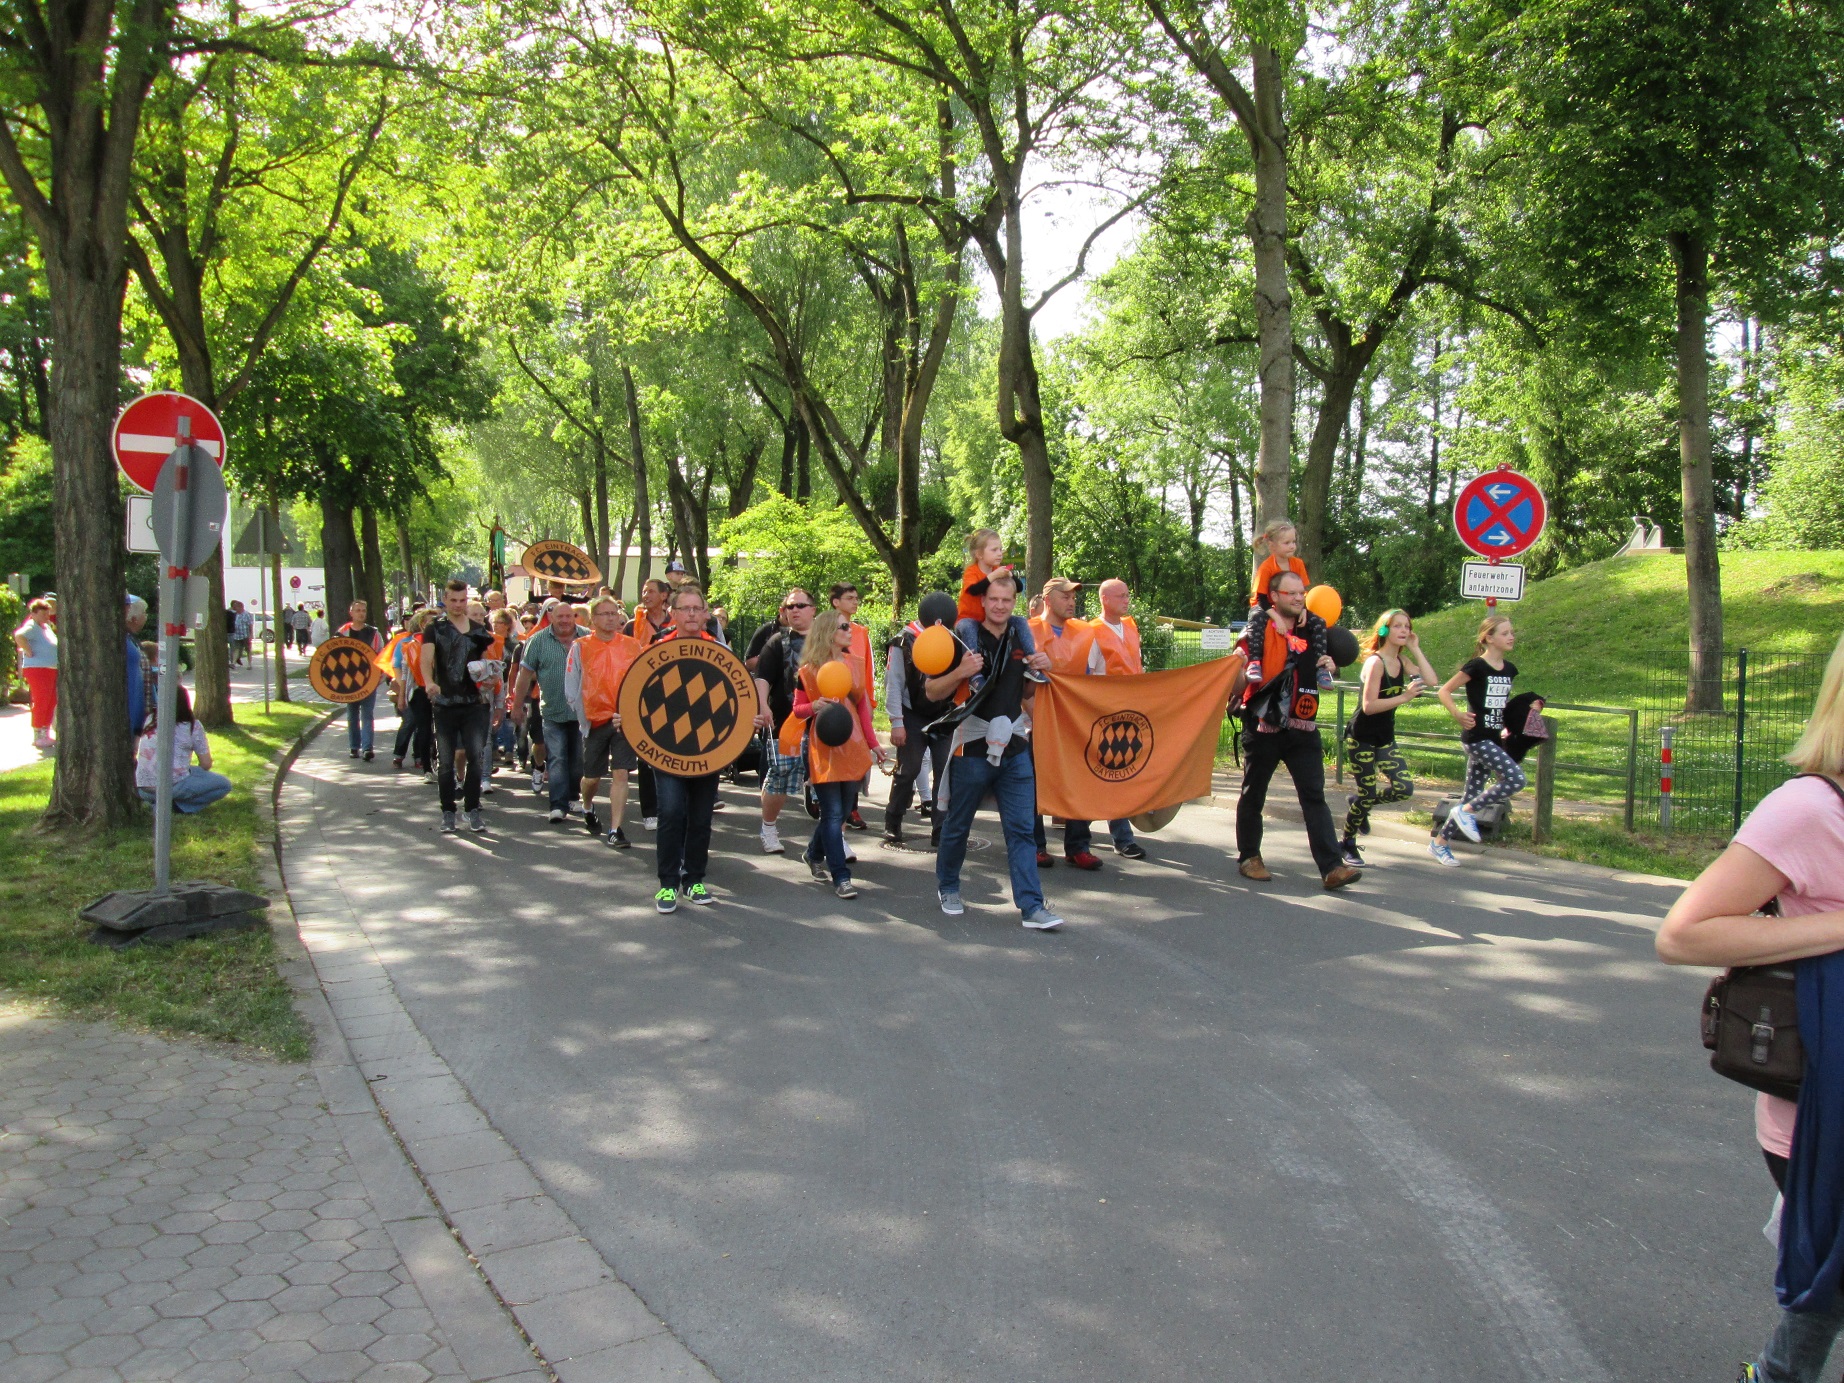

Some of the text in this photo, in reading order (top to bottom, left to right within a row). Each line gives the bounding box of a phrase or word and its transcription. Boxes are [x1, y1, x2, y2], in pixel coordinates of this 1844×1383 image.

[545, 543, 592, 565] EINTRACHT
[1469, 583, 1514, 594] anfahrtzone
[326, 639, 371, 655] EINTRACHT
[647, 644, 751, 699] F.C. EINTRACHT
[330, 689, 369, 701] BAYREUTH
[1111, 713, 1149, 731] EINTRACHT
[636, 739, 709, 773] BAYREUTH
[1093, 764, 1137, 779] BAYREUTH
